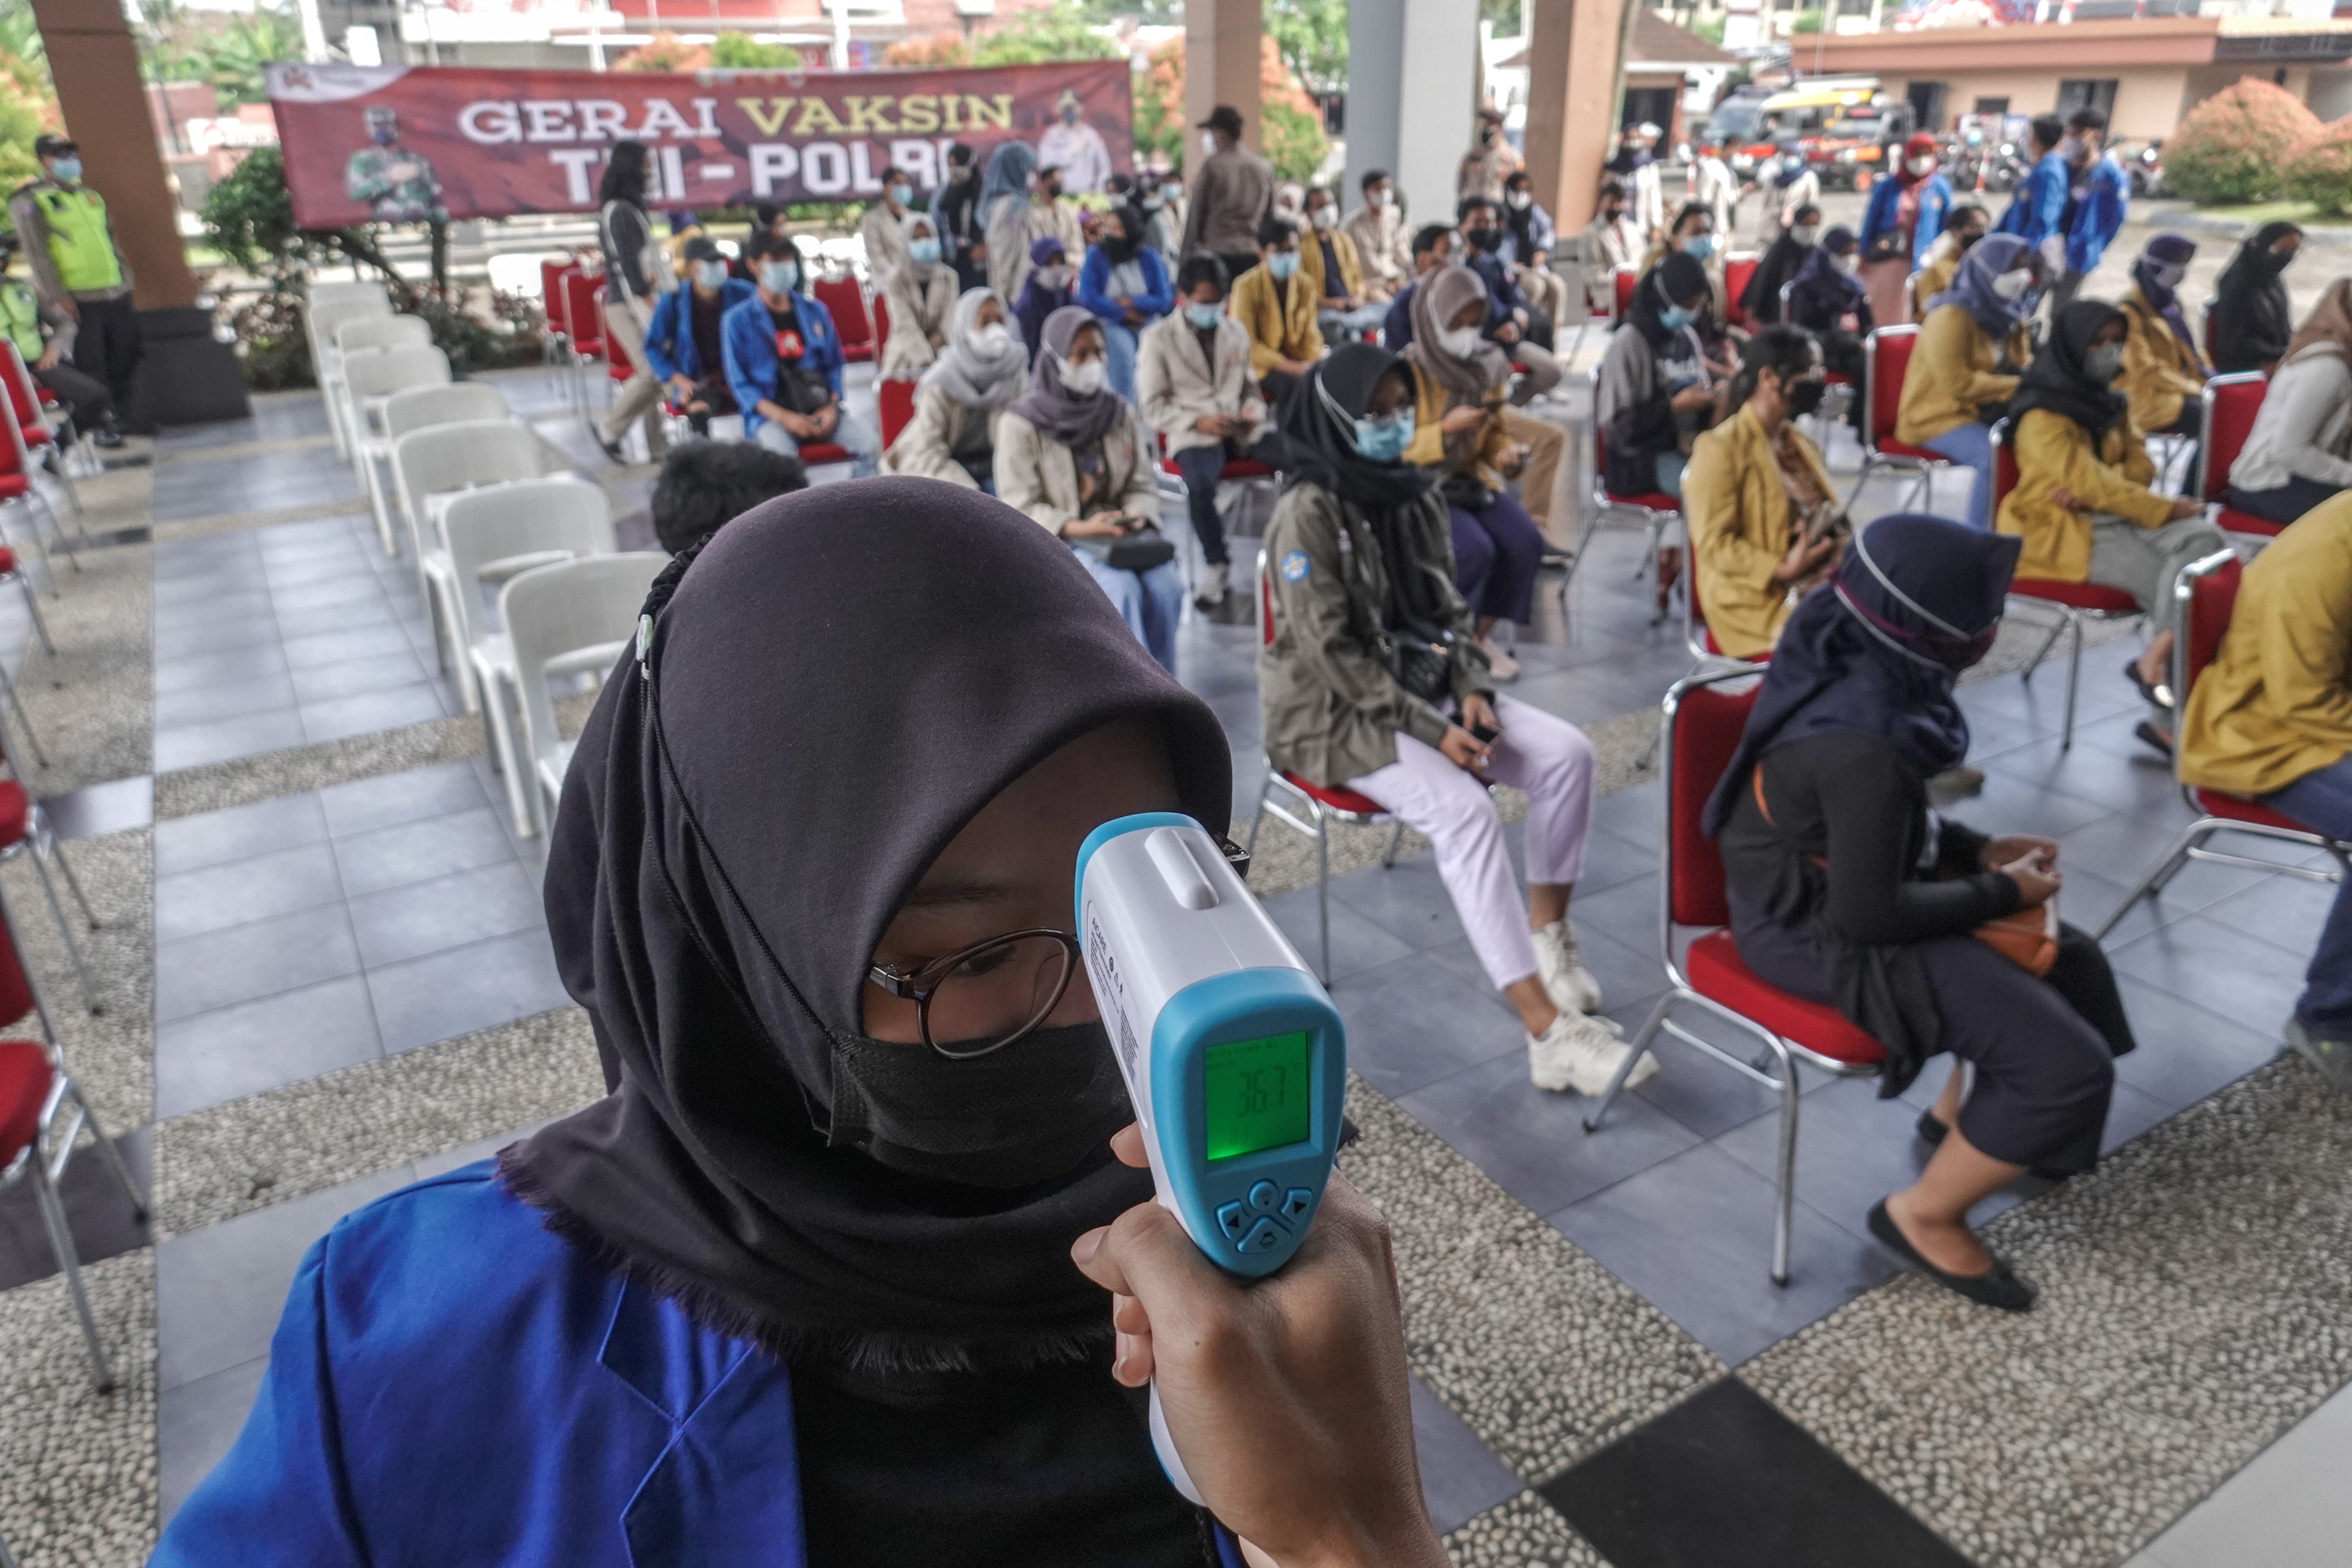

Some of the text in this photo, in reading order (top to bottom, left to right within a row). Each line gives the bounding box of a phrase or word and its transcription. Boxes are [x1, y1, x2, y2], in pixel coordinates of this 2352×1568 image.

[457, 93, 1015, 145] GERAI VAKSIN
[548, 145, 686, 205] TI
[1092, 918, 1107, 955] AICARE
